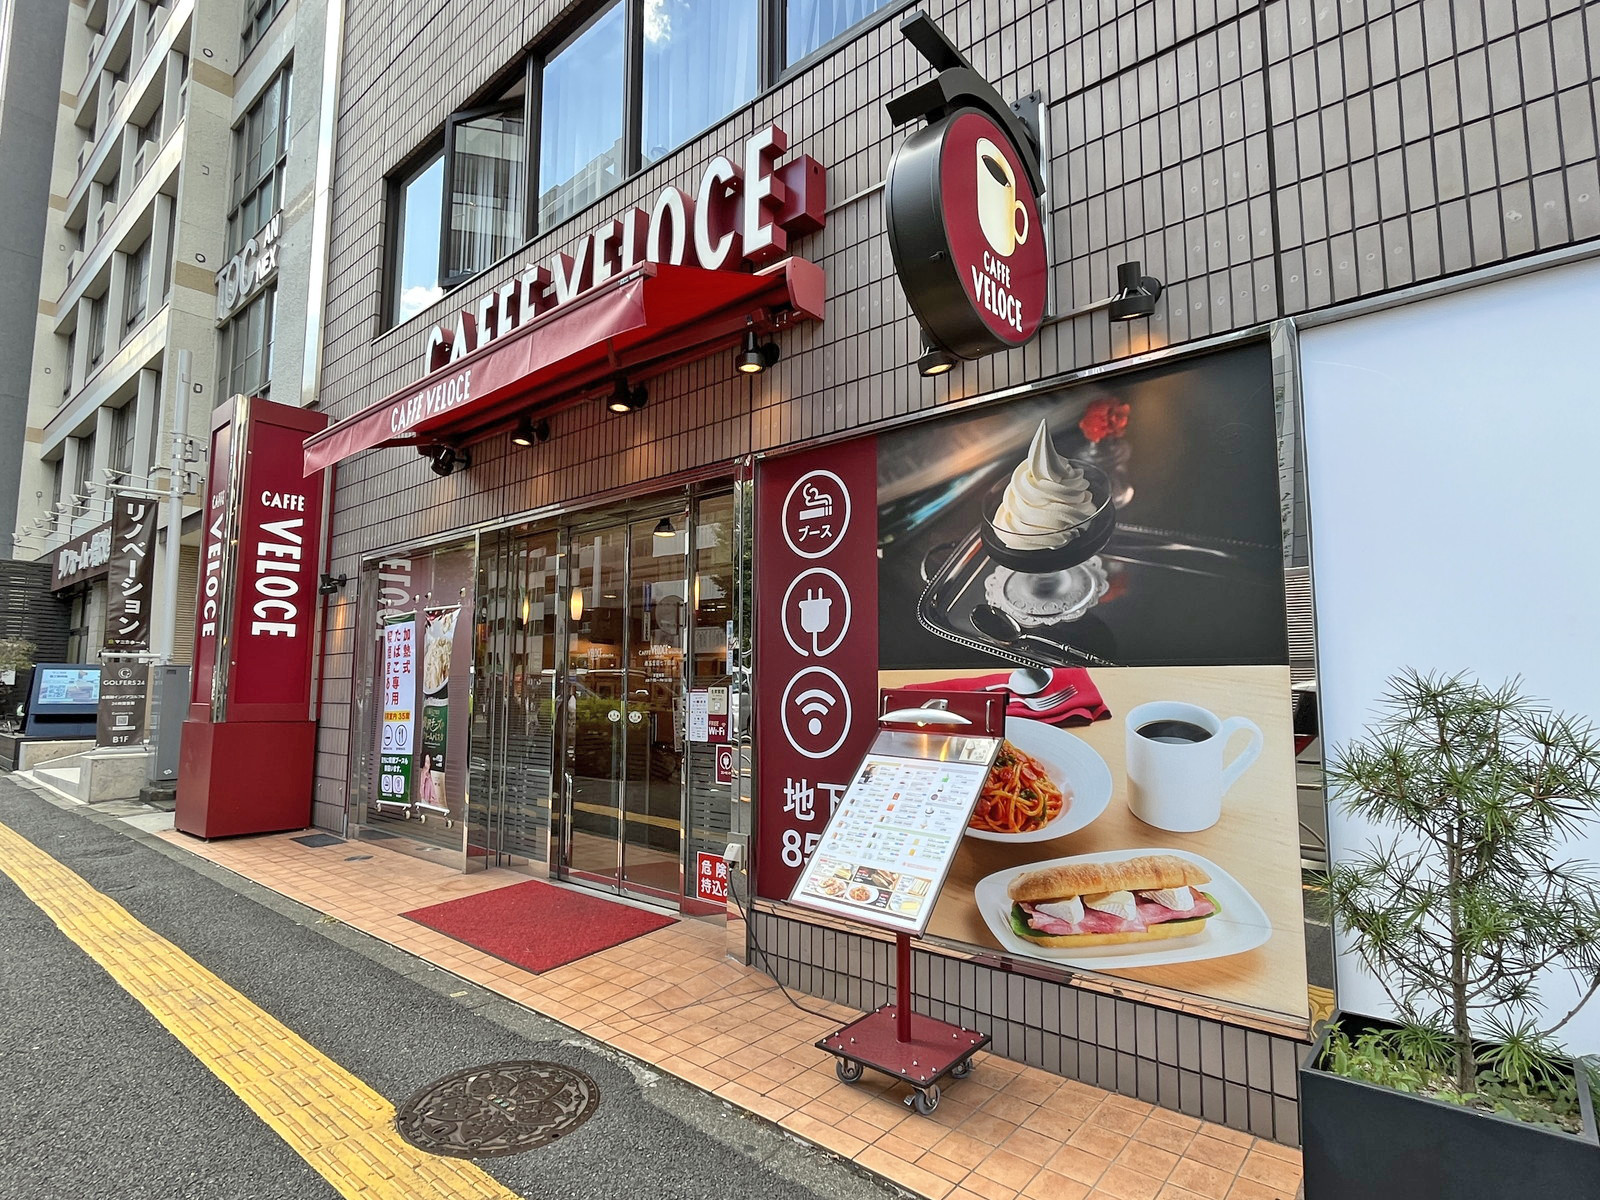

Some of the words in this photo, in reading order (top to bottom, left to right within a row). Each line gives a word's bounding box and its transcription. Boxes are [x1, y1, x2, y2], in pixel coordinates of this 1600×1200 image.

[263, 213, 280, 249] AN
[551, 124, 785, 308] VELOCE
[215, 238, 257, 320] TOC
[256, 243, 277, 283] NEX
[971, 264, 1023, 333] VELOCE
[426, 369, 472, 415] VELOCE
[798, 524, 833, 542] ブース
[118, 503, 146, 635] リノベーション
[202, 513, 224, 638] VELOCE
[251, 518, 304, 638] VELOCE
[391, 629, 401, 706] たばこ専用
[402, 627, 411, 674] 加熱式
[112, 735, 129, 743] B1F
[708, 726, 725, 736] Wi-Fi
[701, 860, 727, 879] 危険
